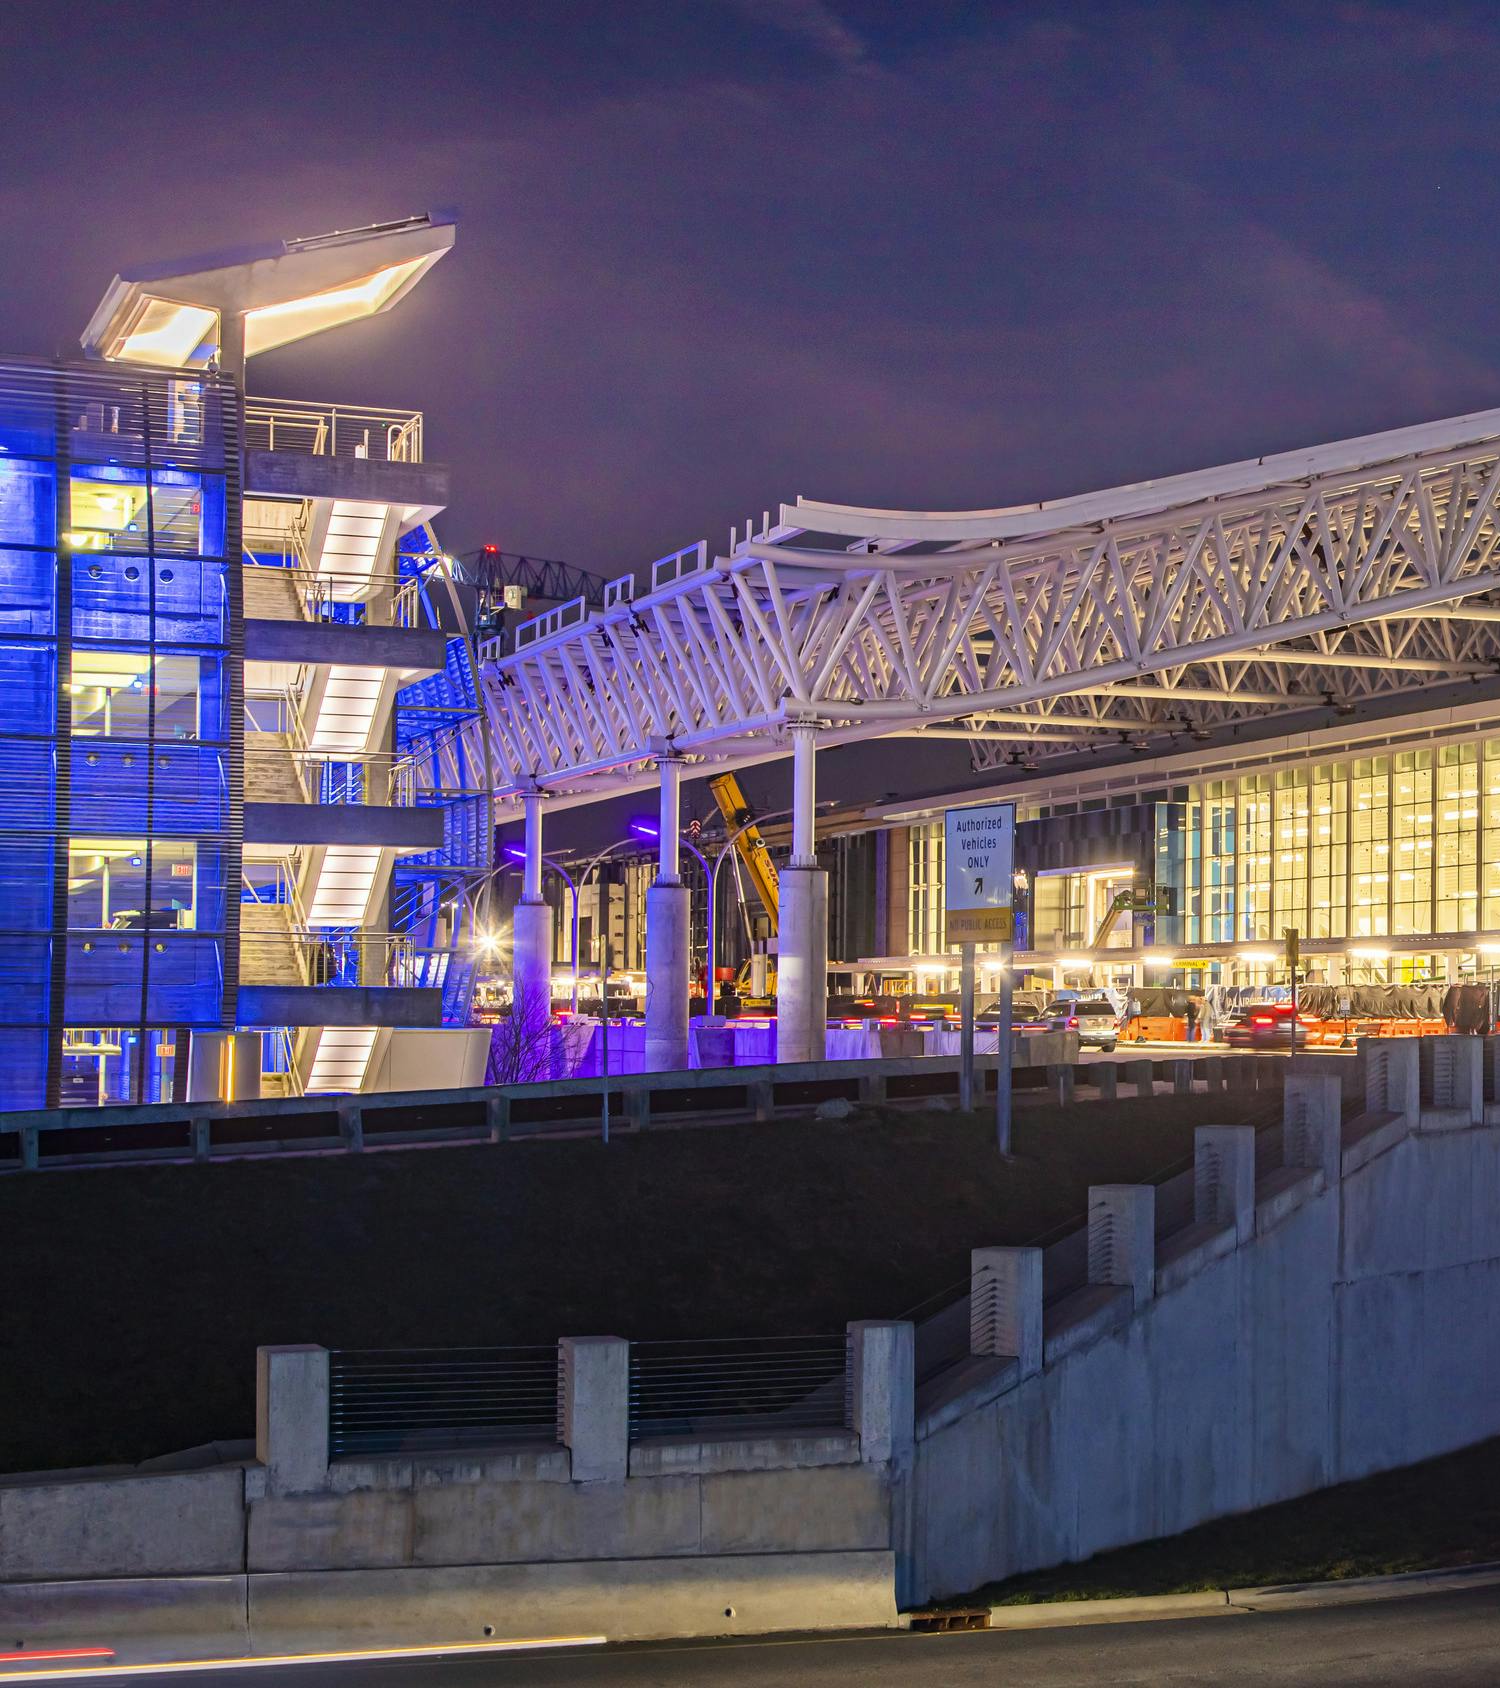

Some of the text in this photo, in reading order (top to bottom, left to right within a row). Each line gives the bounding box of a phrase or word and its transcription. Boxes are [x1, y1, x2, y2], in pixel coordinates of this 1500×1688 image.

[956, 815, 1002, 832] Authorized
[961, 838, 997, 850] Vehicles
[967, 855, 990, 869] ONLY
[949, 917, 1007, 931] NO PUBLIC ACCESS
